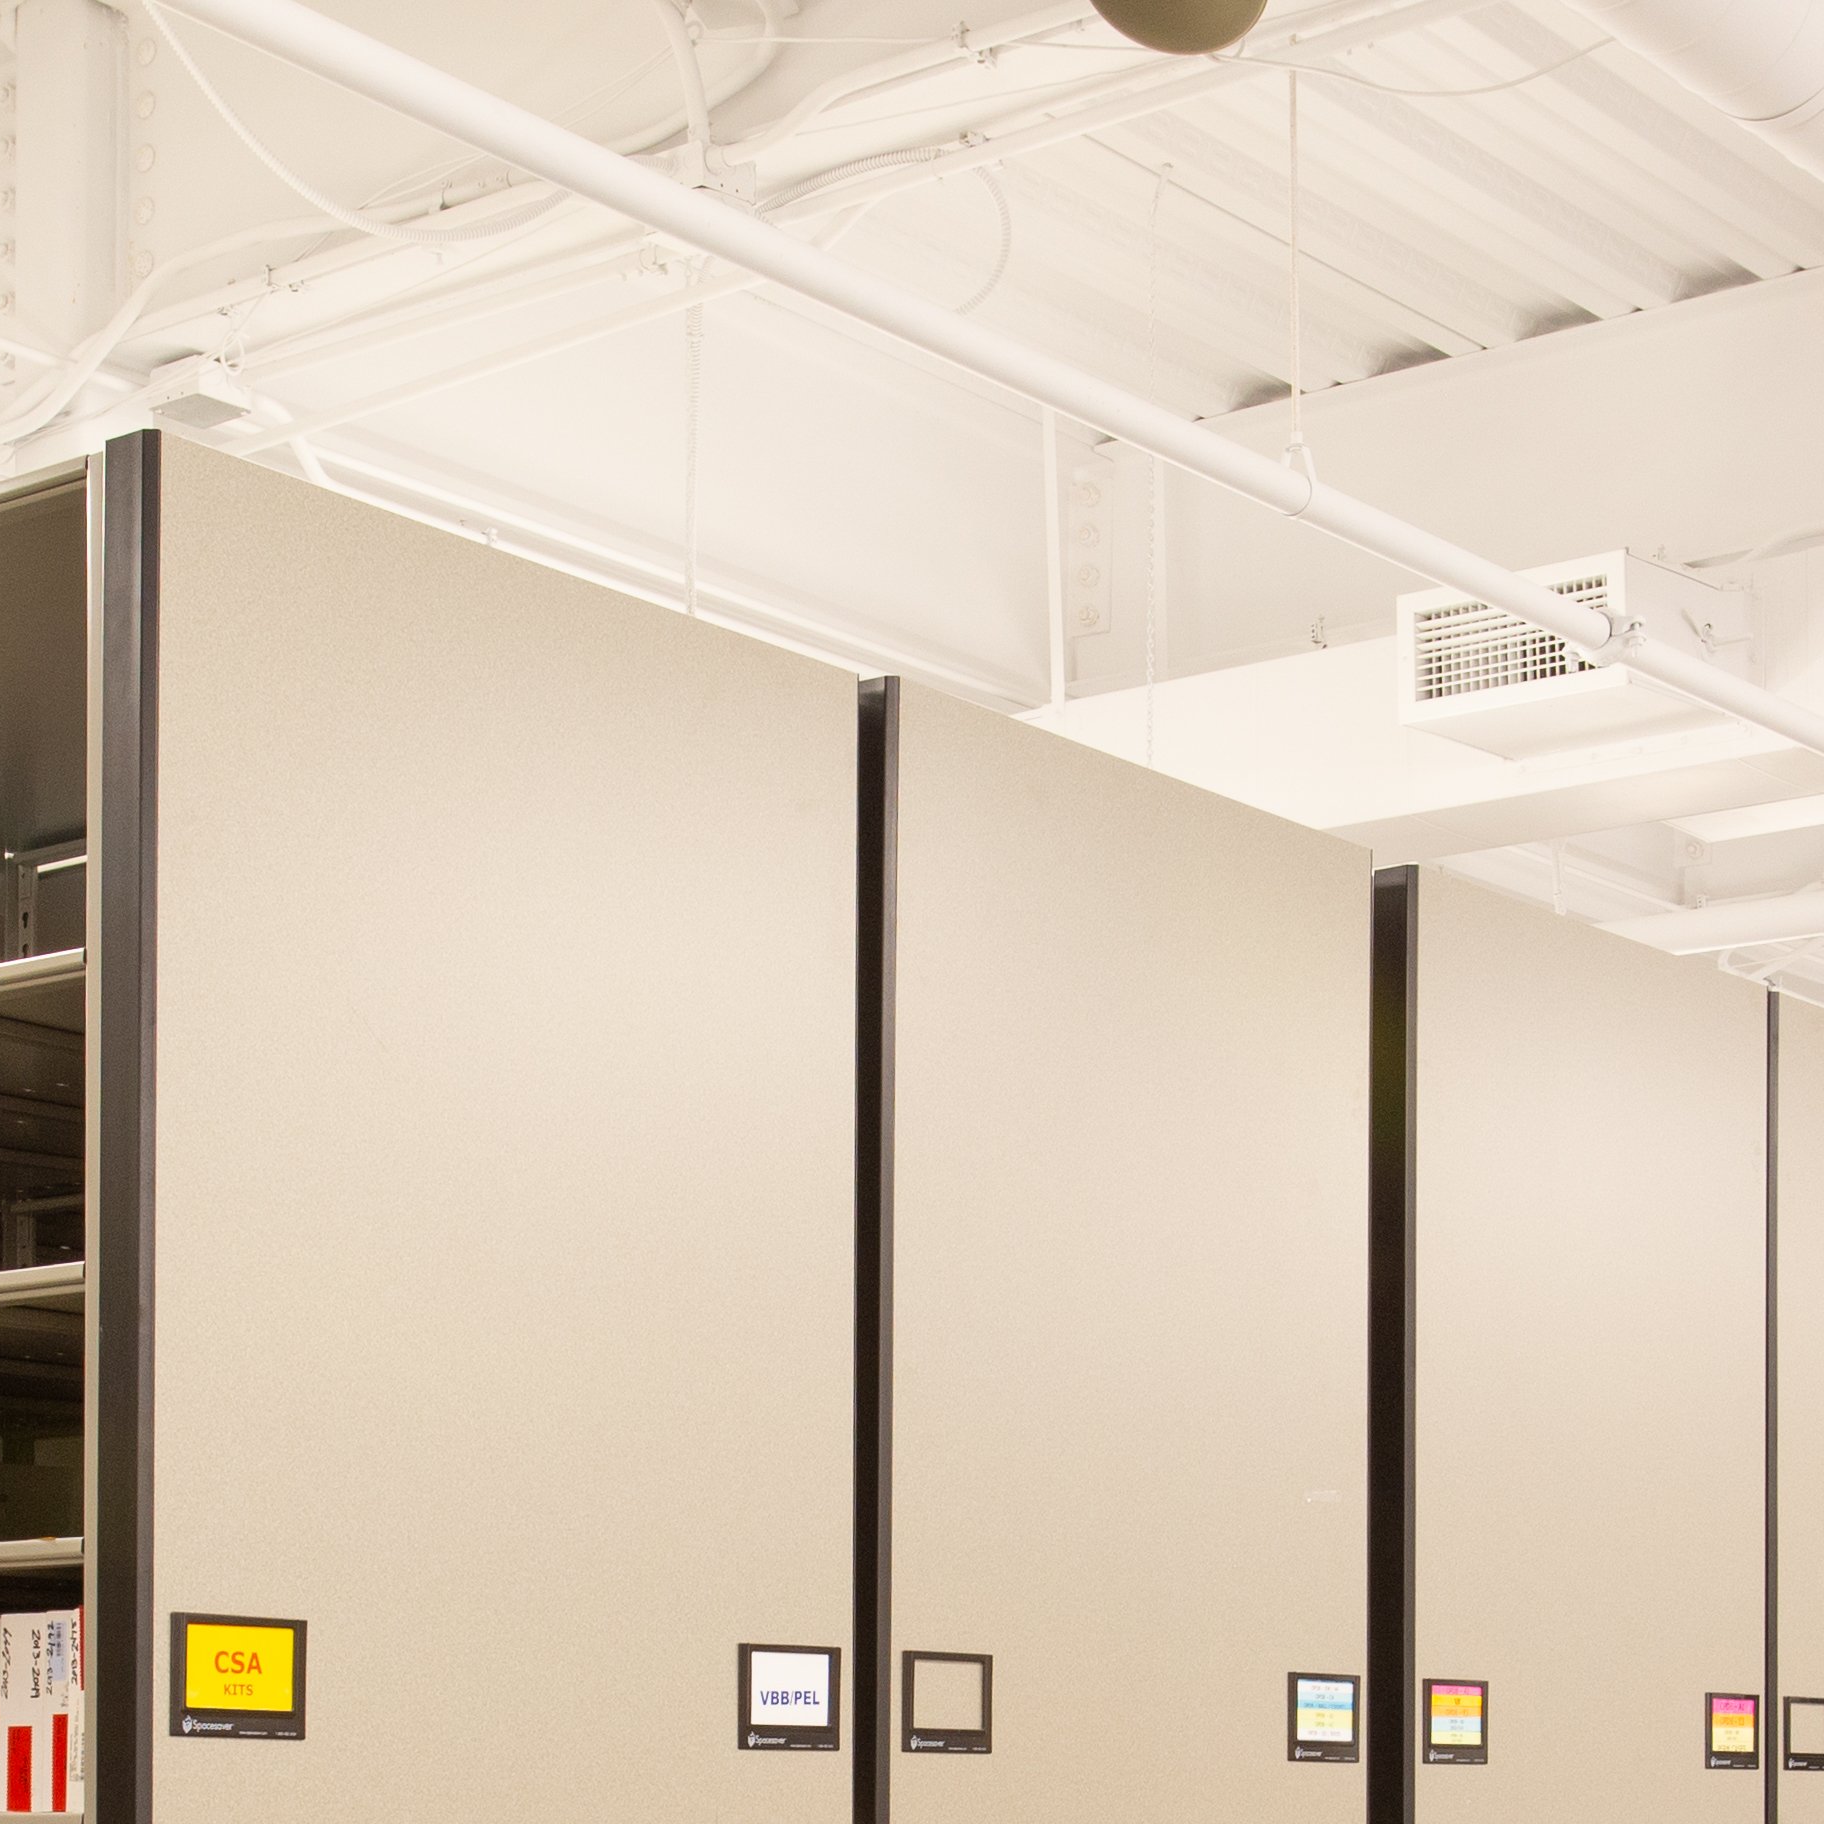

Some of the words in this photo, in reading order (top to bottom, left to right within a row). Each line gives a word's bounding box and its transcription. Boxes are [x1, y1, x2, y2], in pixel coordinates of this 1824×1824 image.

[214, 1651, 262, 1675] CSA
[223, 1684, 254, 1696] KITS
[760, 1690, 821, 1706] VBB/PEL
[192, 1719, 235, 1733] Spacesaver
